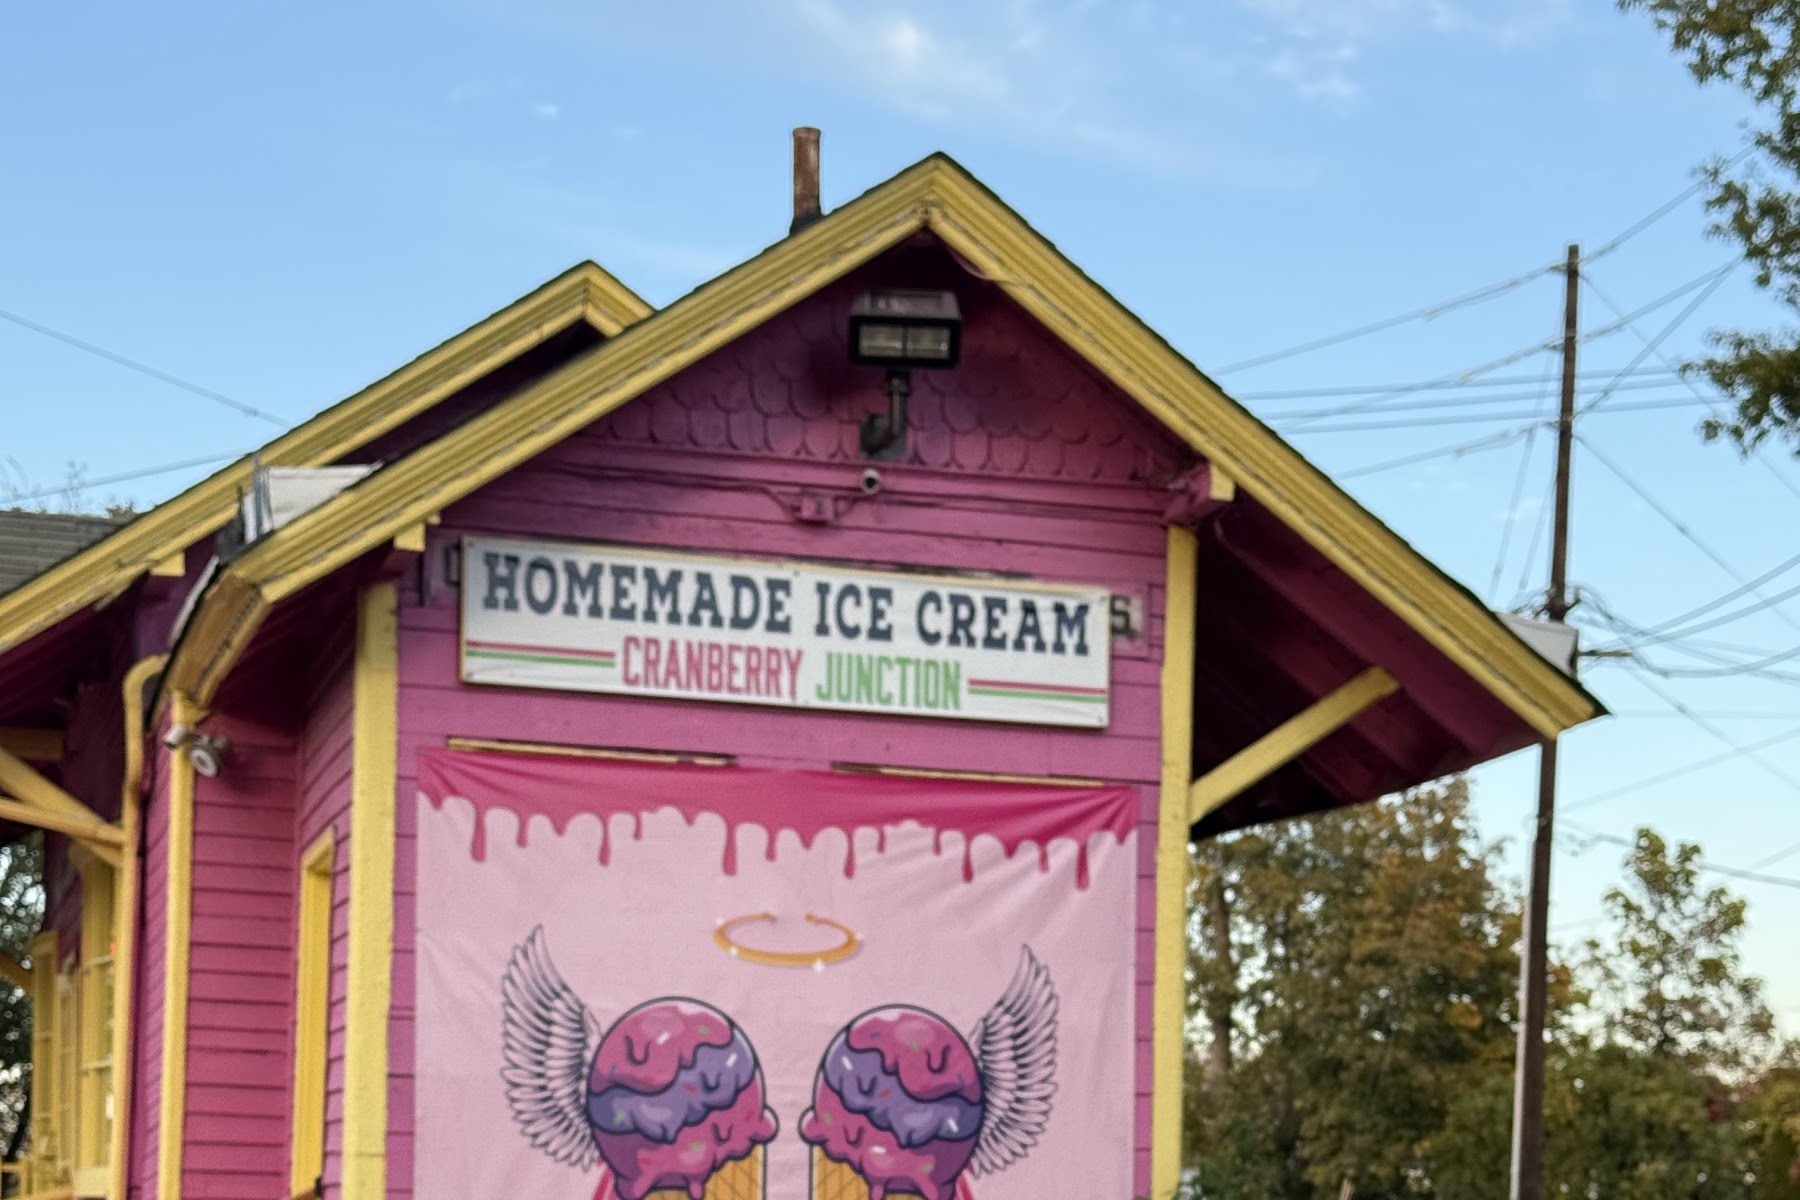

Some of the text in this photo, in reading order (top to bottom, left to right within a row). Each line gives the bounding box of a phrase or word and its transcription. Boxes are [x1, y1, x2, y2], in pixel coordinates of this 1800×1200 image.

[484, 552, 792, 634] HOMEMADE
[815, 581, 893, 642] ICE
[916, 590, 1090, 656] CREAM
[622, 635, 961, 710] CRANBERRY JUNCTION
